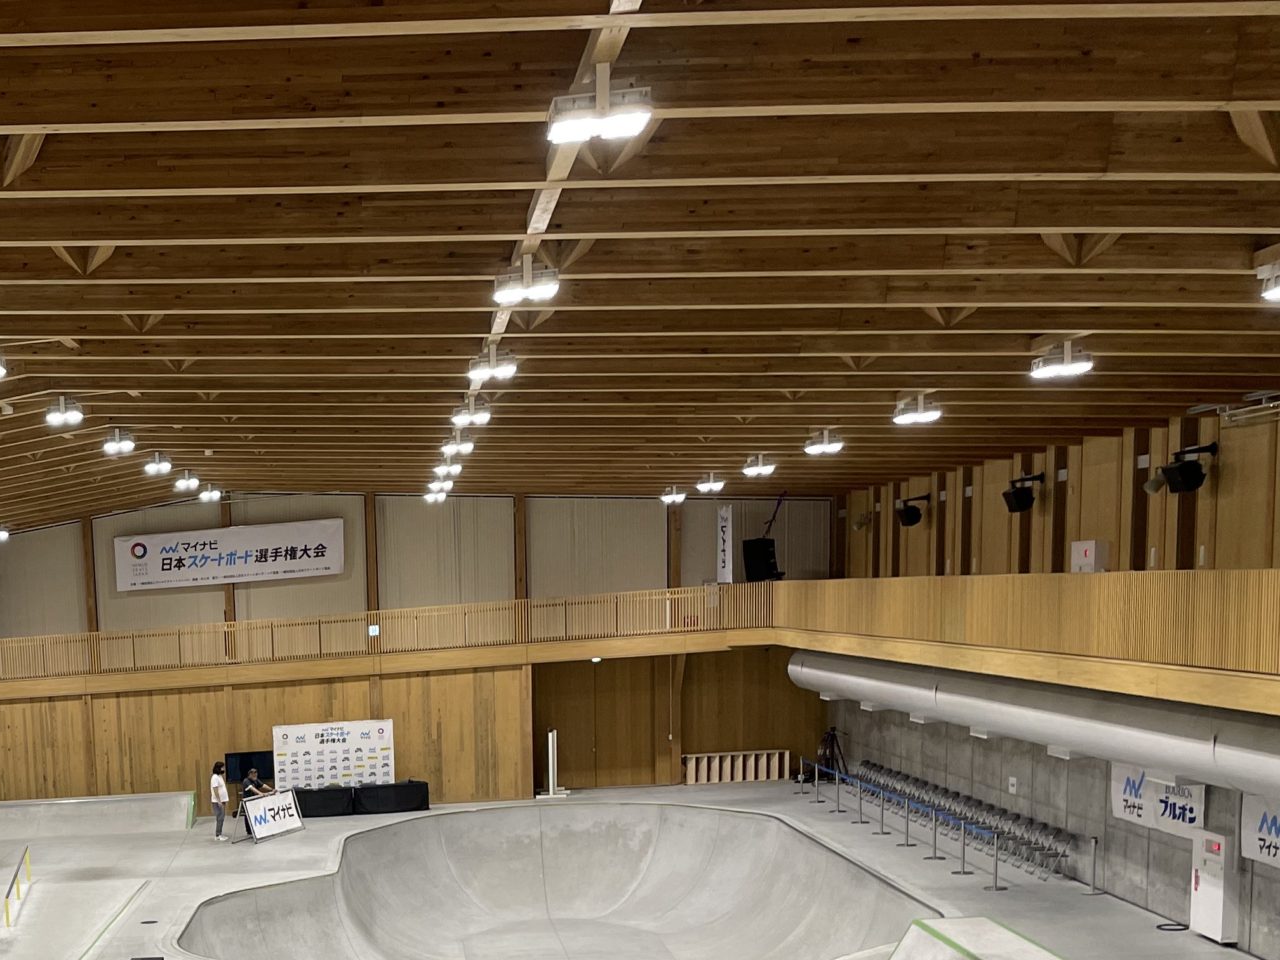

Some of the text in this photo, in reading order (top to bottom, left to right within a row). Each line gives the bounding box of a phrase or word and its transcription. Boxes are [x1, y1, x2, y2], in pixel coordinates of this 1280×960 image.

[181, 540, 218, 552] マイナビ
[161, 543, 327, 571] 日本スケートボード選手権大会
[268, 802, 295, 821] マイナビ
[1123, 799, 1143, 817] マイナビ
[1159, 796, 1196, 824] ブルボン
[1258, 837, 1280, 858] マイナ
